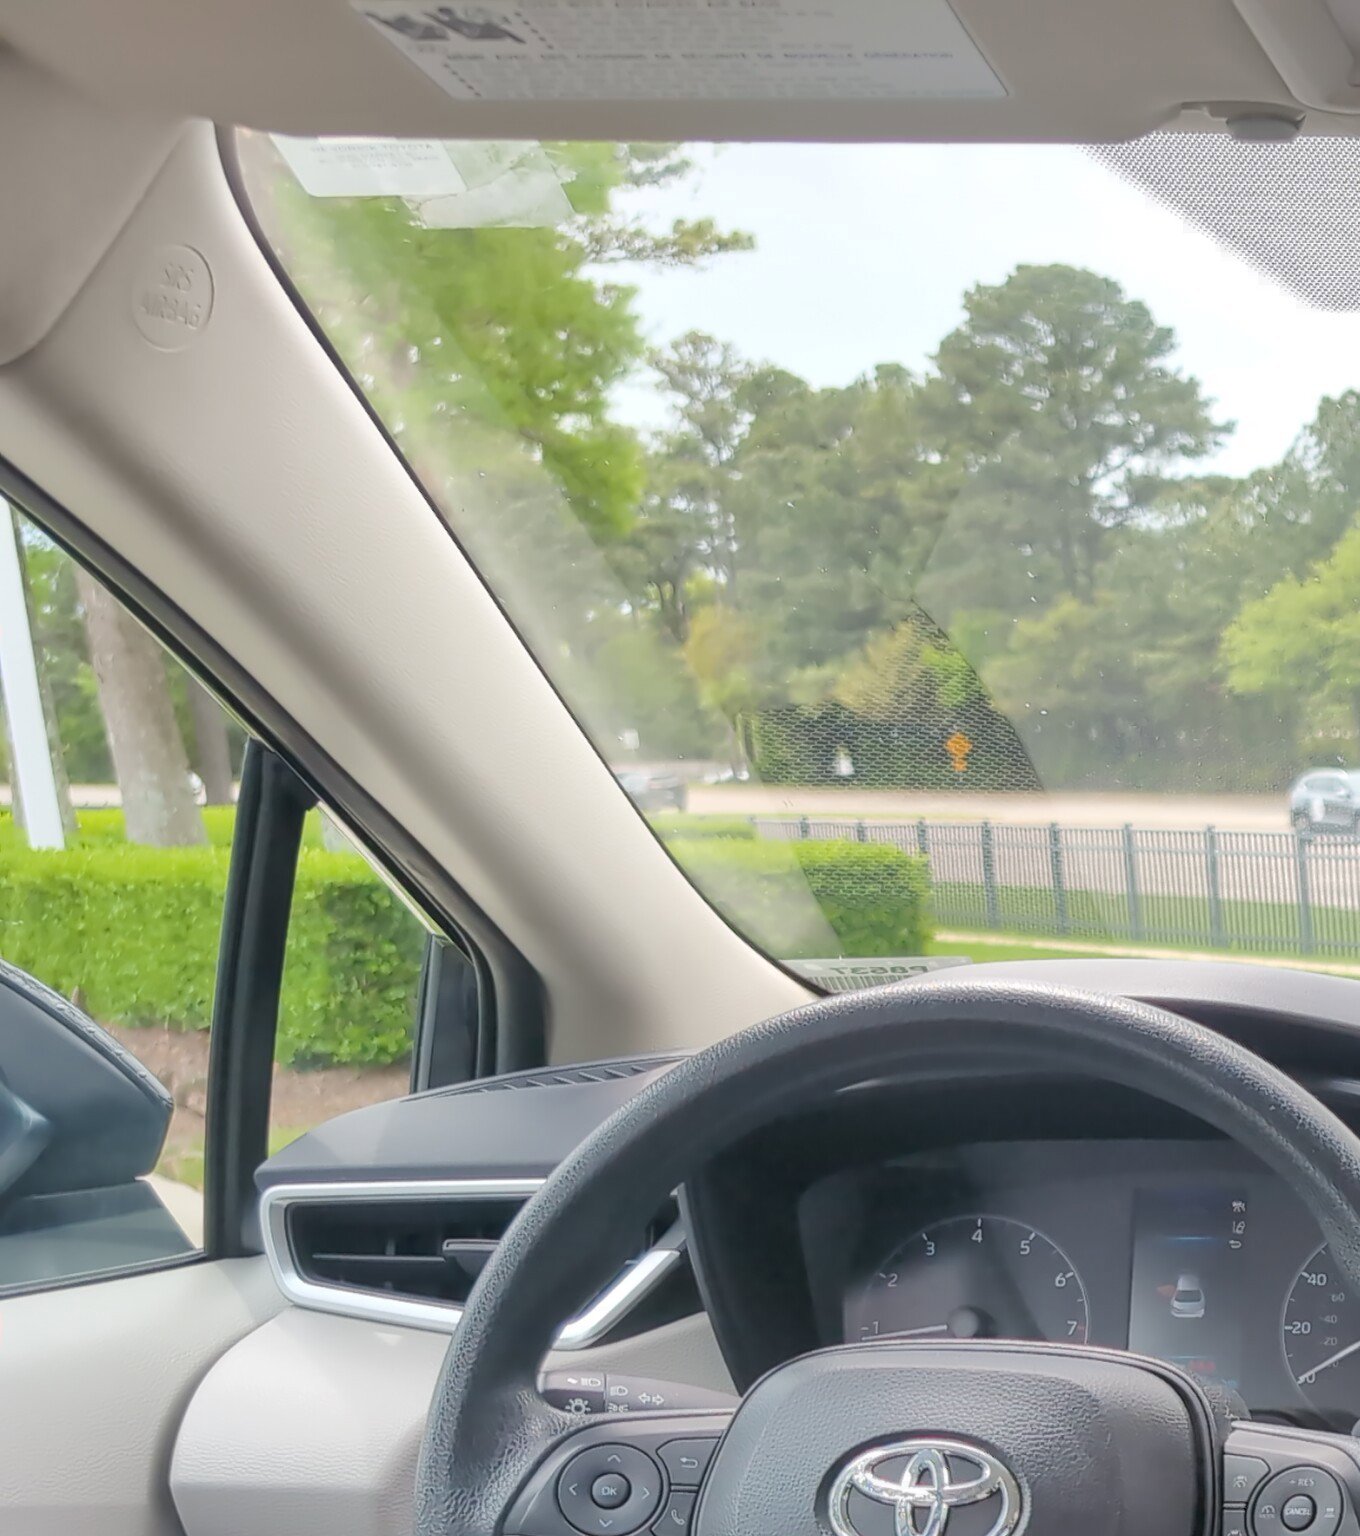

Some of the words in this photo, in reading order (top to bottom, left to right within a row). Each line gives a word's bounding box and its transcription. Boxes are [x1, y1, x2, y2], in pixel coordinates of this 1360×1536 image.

[971, 1228, 983, 1243] 4
[926, 1241, 936, 1256] 3
[1020, 1240, 1030, 1255] 5
[887, 1273, 898, 1287] 2
[1055, 1273, 1066, 1288] 6
[1307, 1272, 1327, 1286] 40
[1067, 1320, 1078, 1336] 7
[1291, 1321, 1311, 1334] 20
[600, 1486, 618, 1497] OK
[1285, 1507, 1312, 1516] CANCEL
